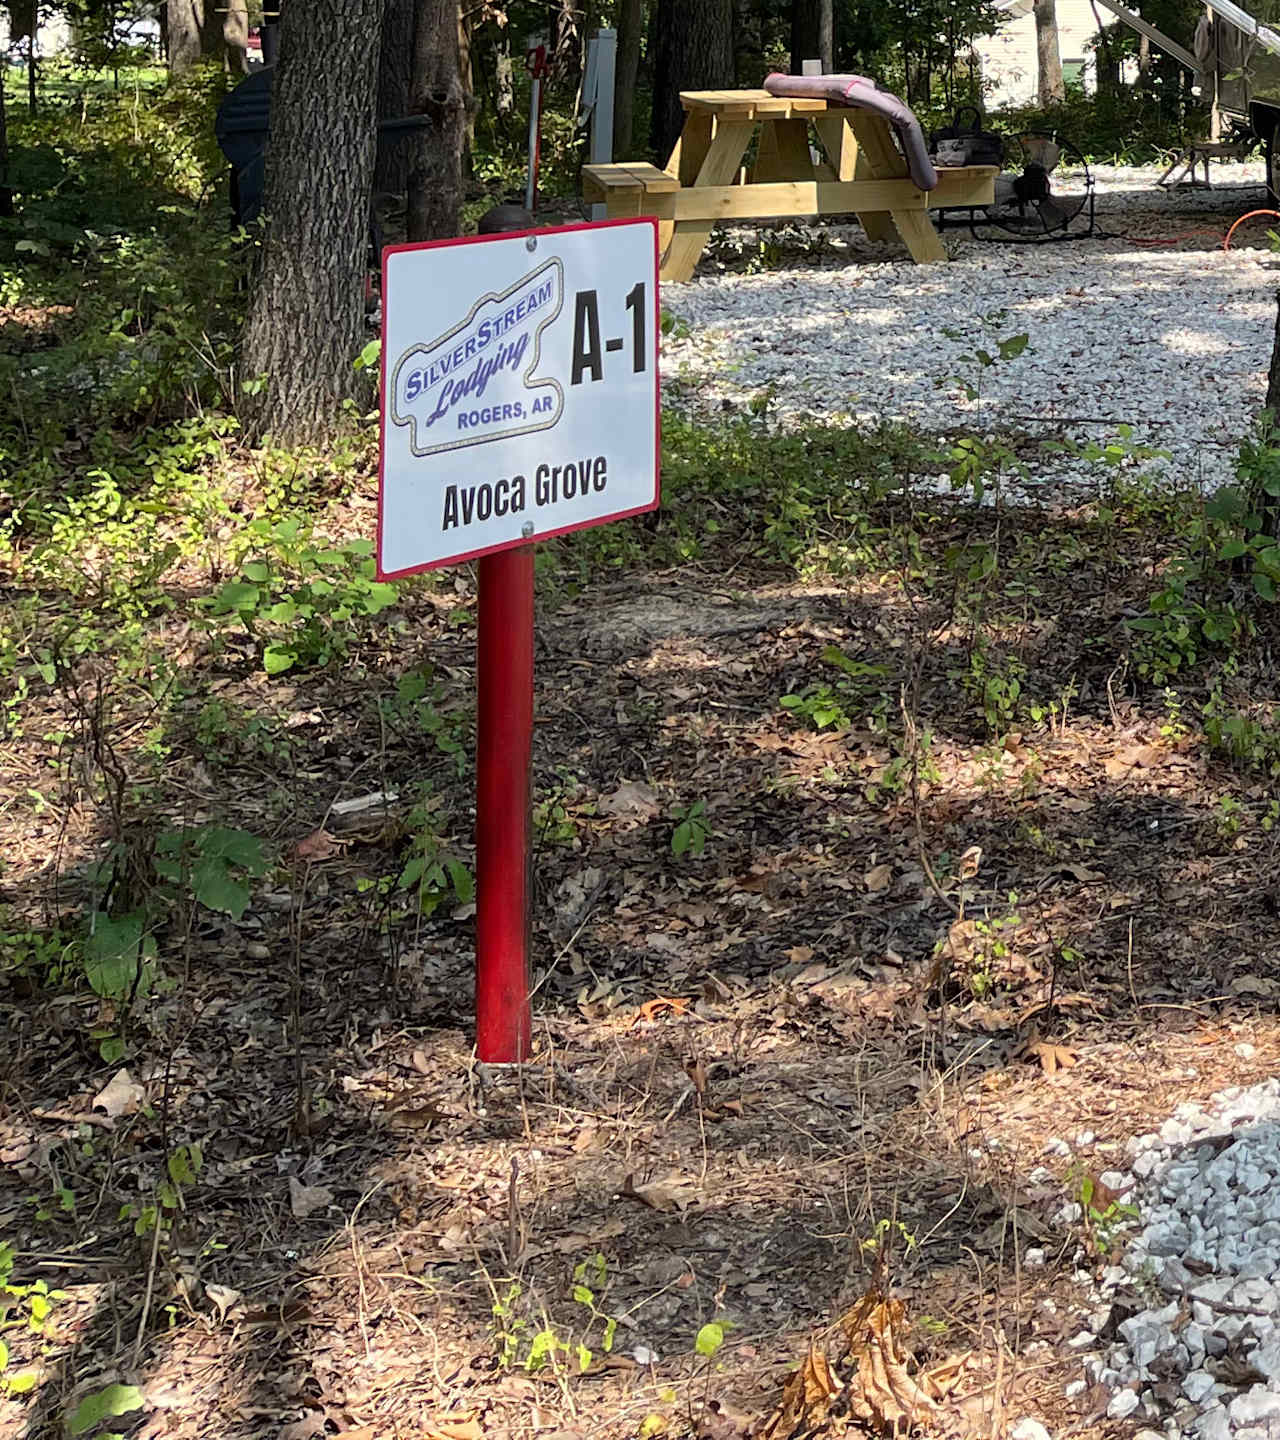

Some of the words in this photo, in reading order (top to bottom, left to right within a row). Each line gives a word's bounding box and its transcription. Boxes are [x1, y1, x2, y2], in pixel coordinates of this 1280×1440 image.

[570, 281, 647, 386] A-1
[426, 330, 530, 428] Lodging
[457, 403, 528, 430] ROGERS,
[531, 395, 553, 415] AR
[441, 473, 526, 532] Avoca
[535, 454, 608, 507] Grove
